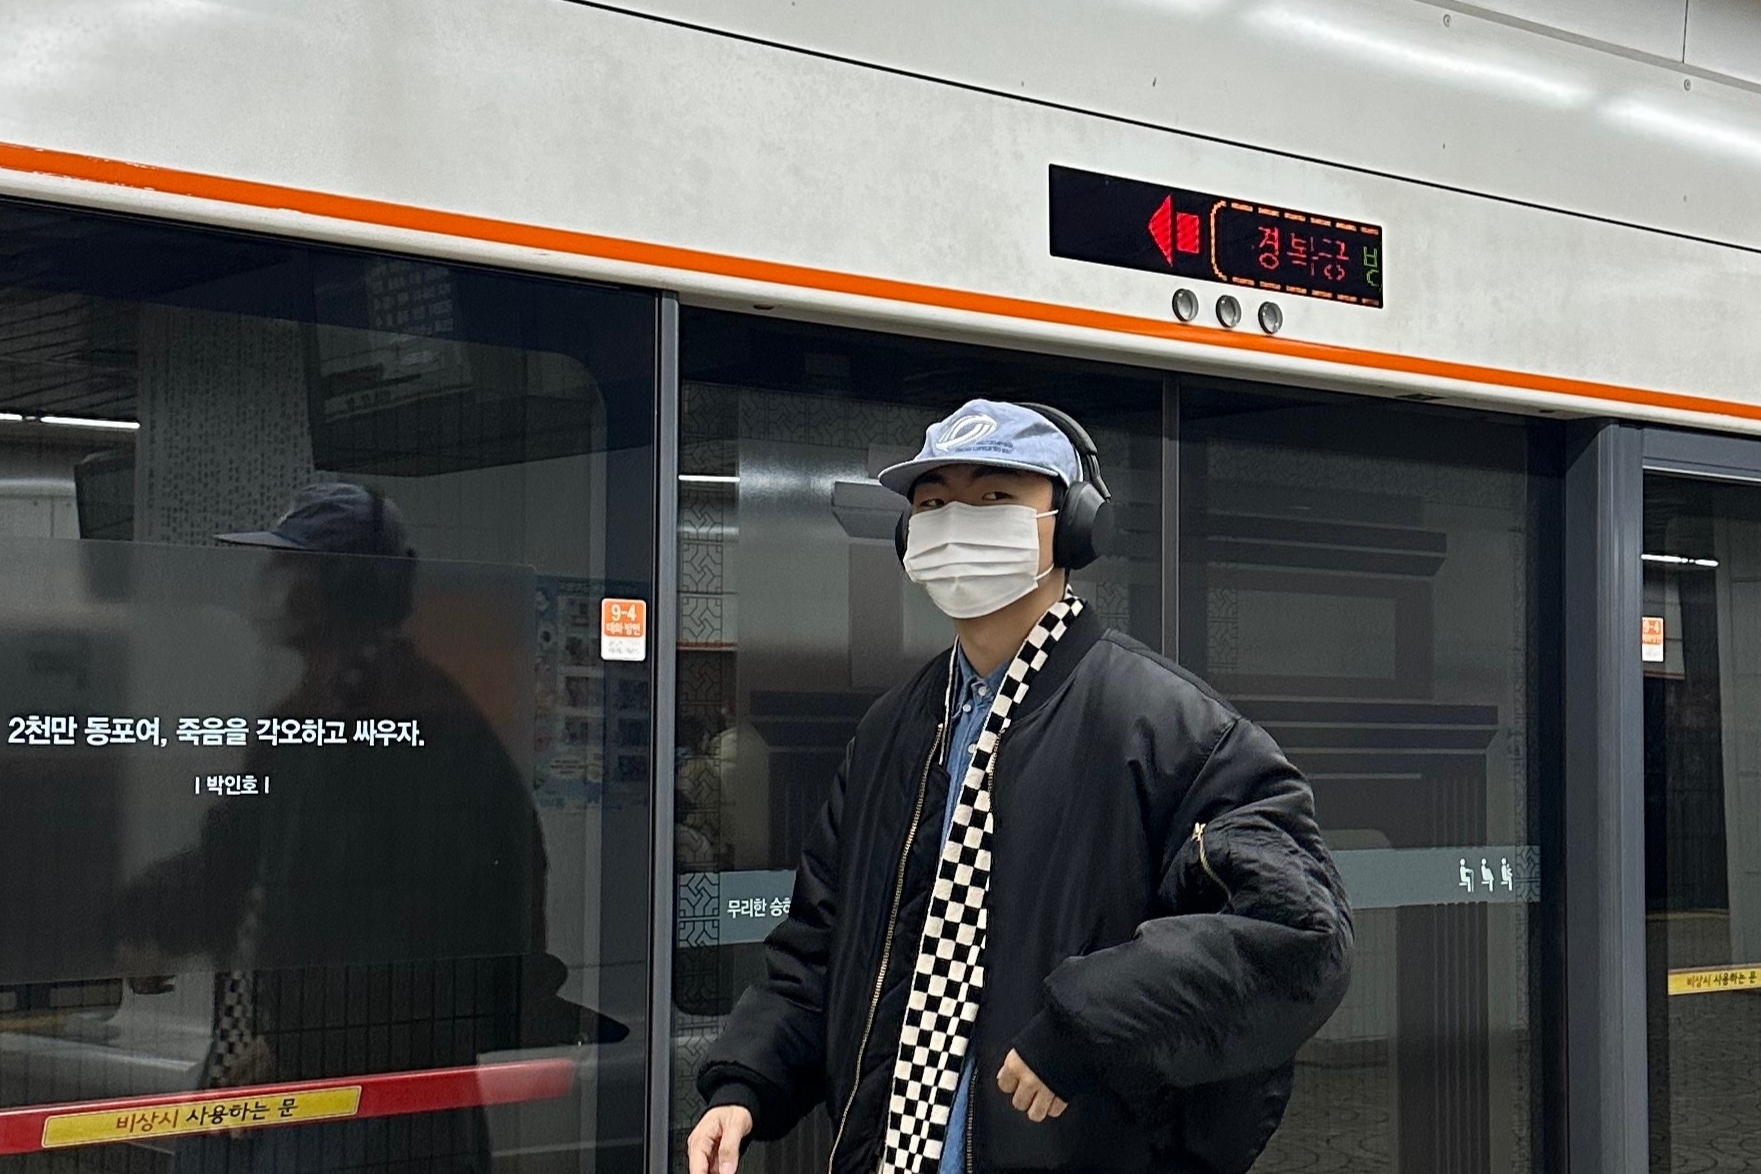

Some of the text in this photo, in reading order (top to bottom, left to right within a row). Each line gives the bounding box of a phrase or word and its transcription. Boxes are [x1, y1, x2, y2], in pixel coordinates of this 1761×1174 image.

[1258, 227, 1349, 281] 경복궁
[611, 604, 637, 621] 9-4
[8, 716, 424, 747] 2천만 동포여, 죽음을 각오하고 싸우자.
[207, 776, 258, 795] 박인호
[728, 899, 767, 918] 무리한
[116, 1098, 298, 1133] 비상시 사용하는 문
